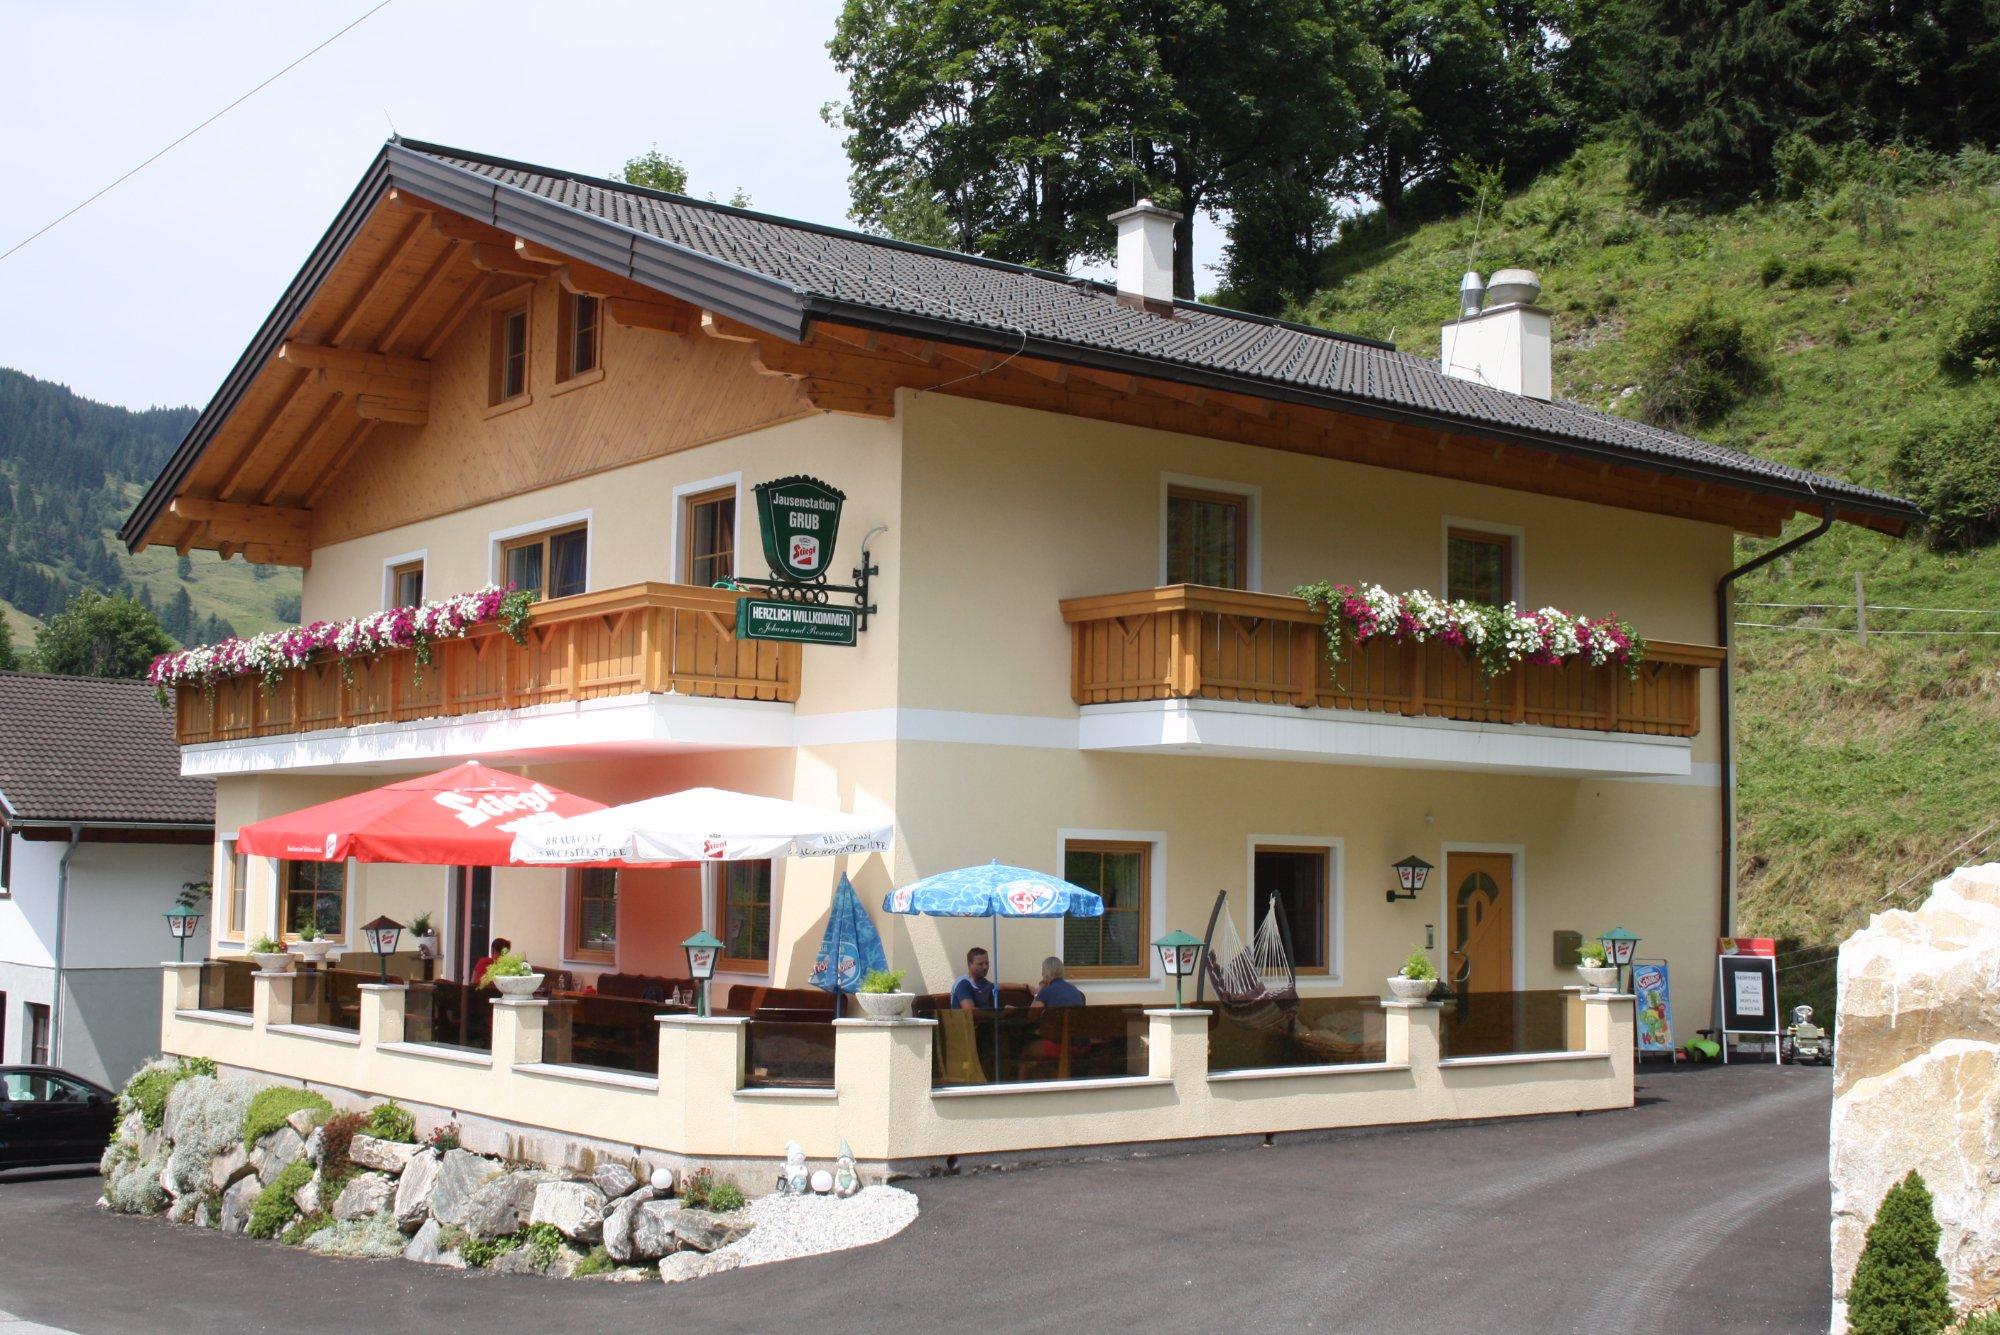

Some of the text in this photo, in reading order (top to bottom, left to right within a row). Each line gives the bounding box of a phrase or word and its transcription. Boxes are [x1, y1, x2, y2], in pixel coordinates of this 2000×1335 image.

[773, 493, 836, 511] Jausenstation
[789, 511, 820, 530] GRUB
[793, 544, 816, 559] Stiegl
[752, 606, 850, 627] HERZLICH WILLKOMMEN
[758, 621, 844, 637] Johann und Rosemarie
